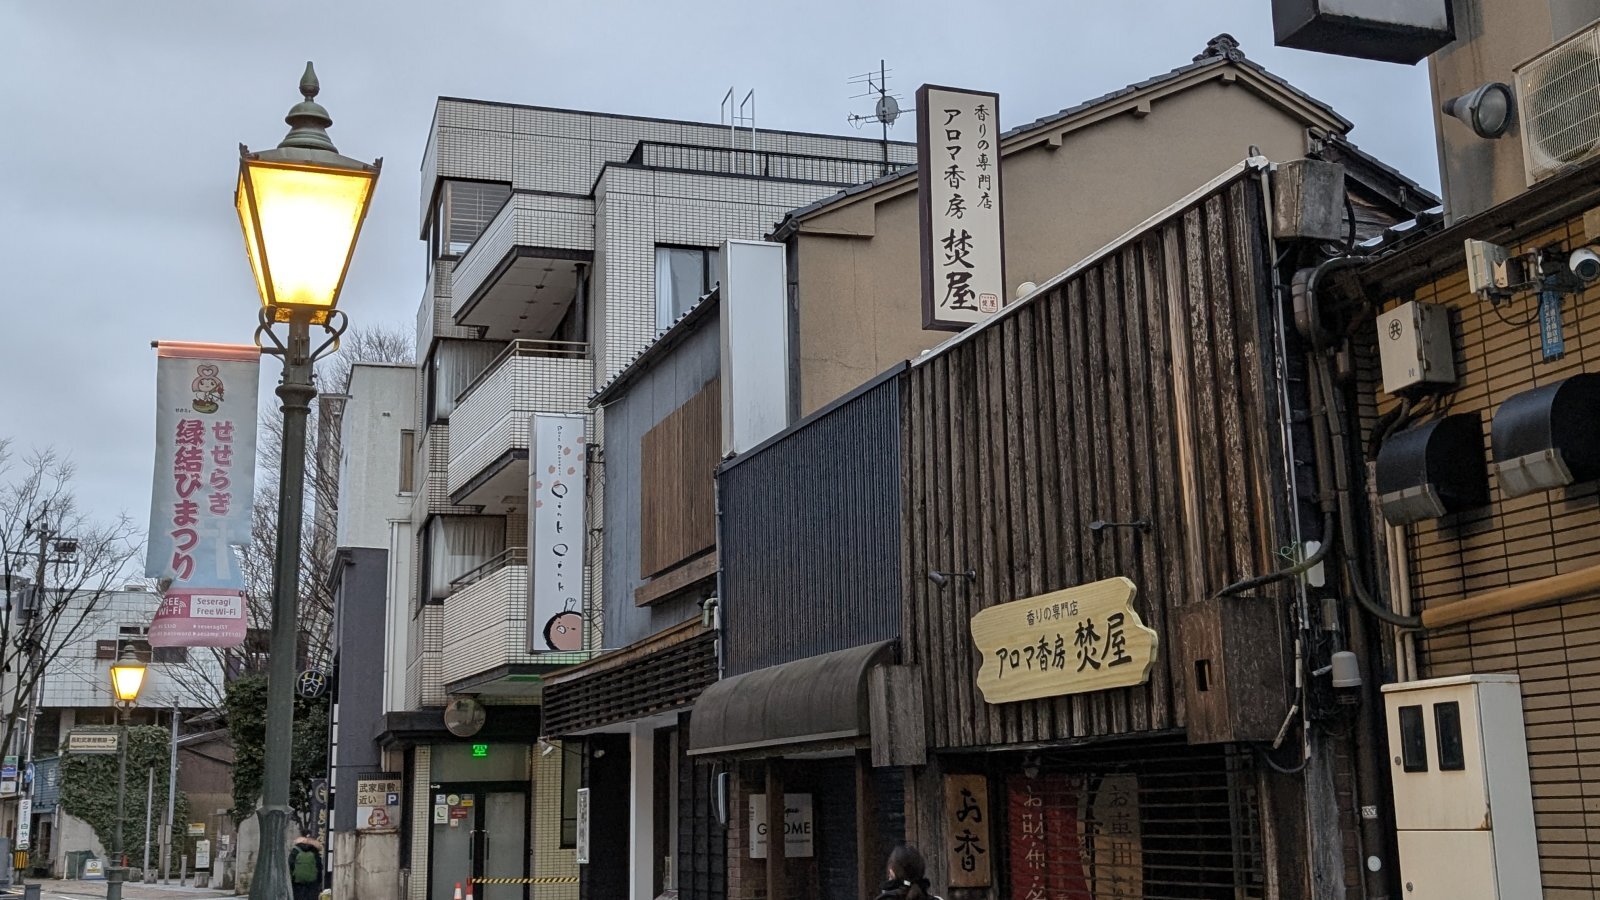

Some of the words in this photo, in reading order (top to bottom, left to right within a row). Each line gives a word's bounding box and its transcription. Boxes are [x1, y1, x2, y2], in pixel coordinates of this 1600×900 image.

[943, 109, 967, 220] アロマ香房
[974, 104, 993, 210] 香りの専門店
[940, 228, 979, 312] 焚屋
[1390, 320, 1401, 339] 共
[208, 420, 234, 515] せせらぎ
[171, 418, 204, 581] 縁結びまつり
[158, 607, 181, 616] Wi-Fi
[196, 597, 231, 607] Seseragi
[196, 607, 215, 616] Free
[216, 608, 236, 616] Wi-Fi
[1026, 600, 1079, 627] 香りの専門店
[995, 633, 1066, 680] アロマ香房
[1074, 612, 1133, 673] 焚屋
[472, 745, 488, 757] 空
[358, 795, 377, 805] 近い
[388, 794, 397, 805] P
[954, 787, 985, 873] お香
